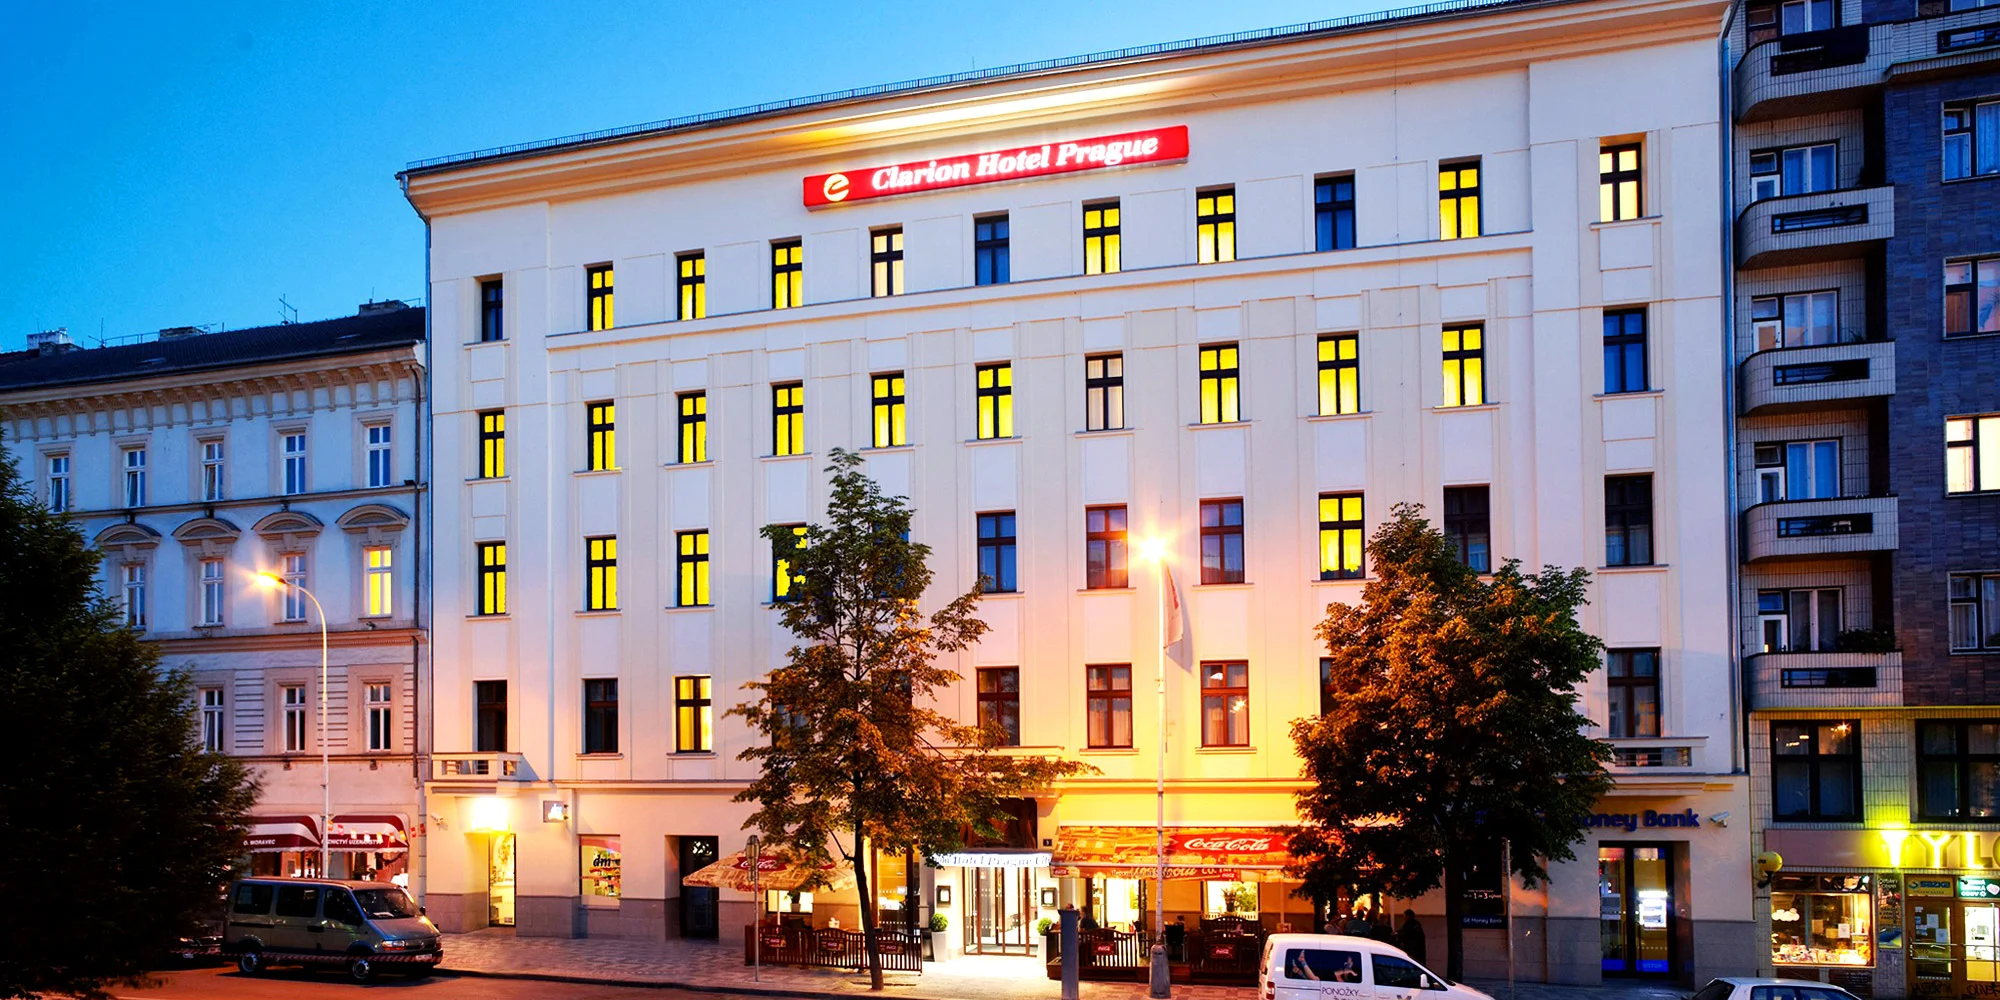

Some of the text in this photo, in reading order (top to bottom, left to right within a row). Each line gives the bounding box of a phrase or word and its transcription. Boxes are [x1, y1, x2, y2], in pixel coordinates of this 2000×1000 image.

[871, 135, 1159, 191] Clarion Hotel Prague
[1643, 807, 1700, 828] Bank
[593, 854, 612, 867] dm
[1880, 831, 2000, 869] TYL
[1321, 986, 1360, 997] PONOŽKY
